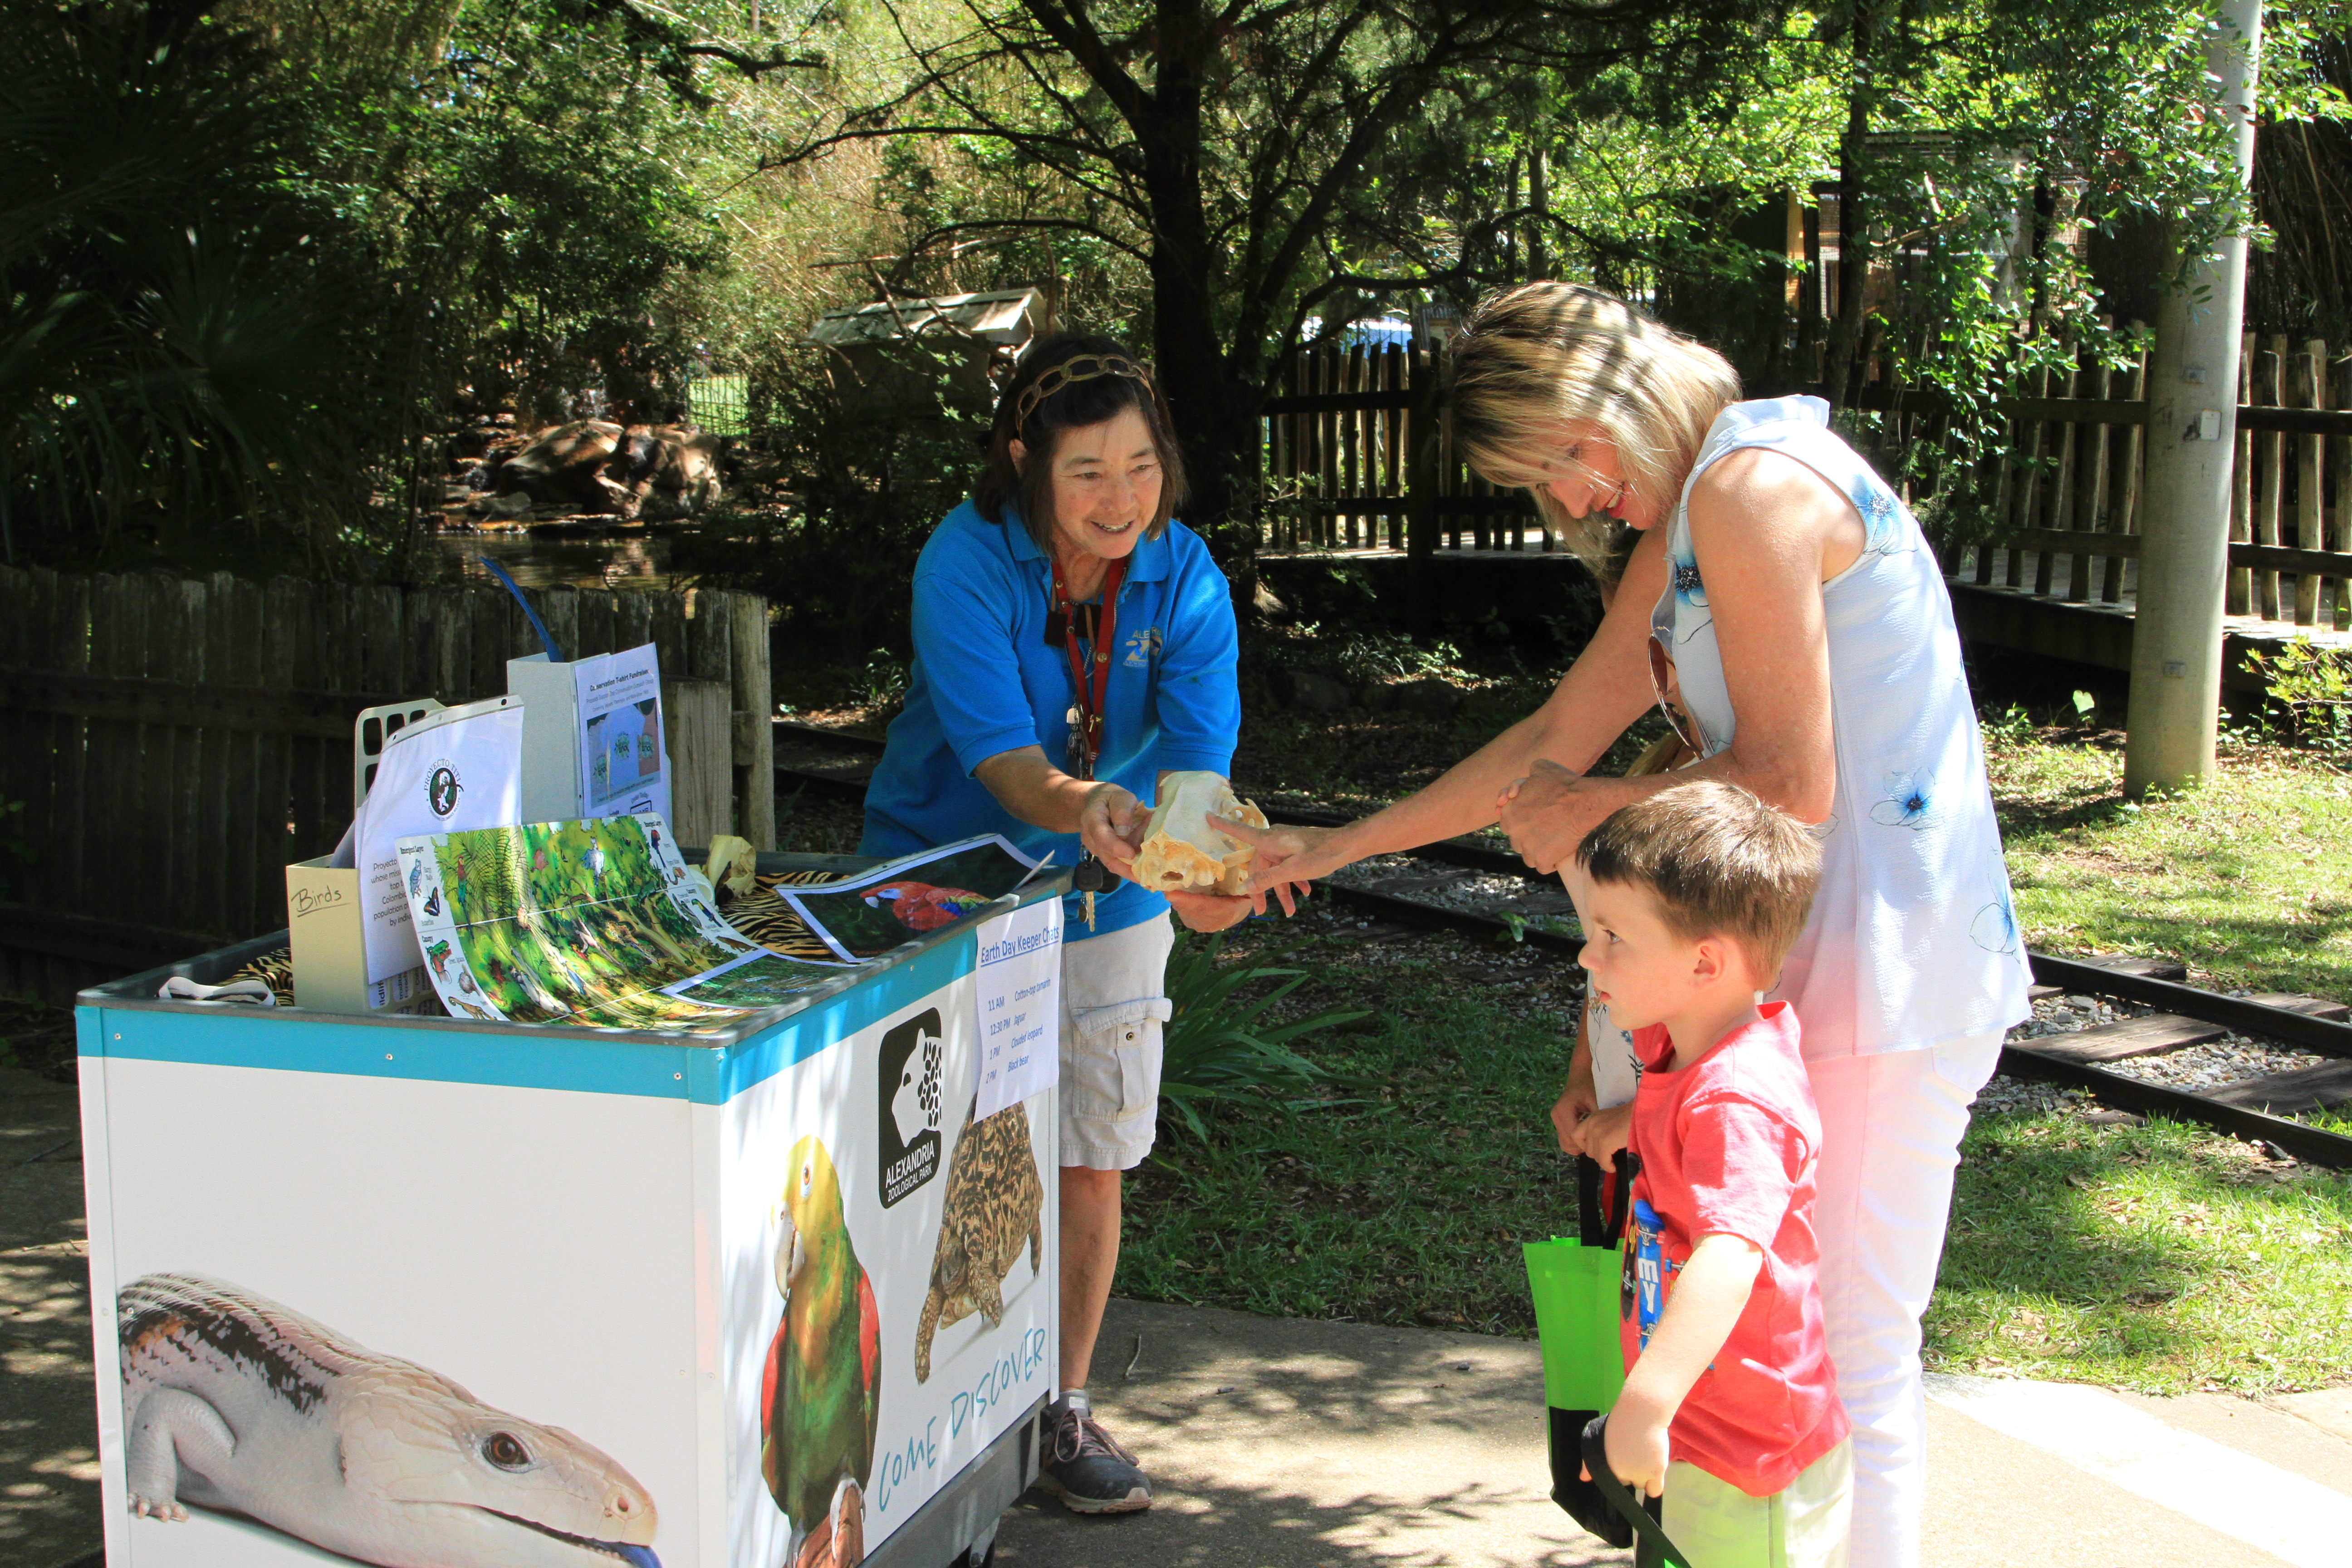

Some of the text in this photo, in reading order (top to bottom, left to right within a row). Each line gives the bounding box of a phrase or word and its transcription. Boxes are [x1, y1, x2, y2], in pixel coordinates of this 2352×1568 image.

[590, 679, 615, 691] Coservation
[424, 759, 450, 791] PROYECTO
[371, 868, 401, 884] whose missi
[373, 858, 397, 871] Proyecto
[291, 885, 342, 912] Birds
[390, 882, 400, 890] top
[374, 906, 402, 921] population
[389, 914, 412, 926] by indiv
[981, 925, 1059, 963] Earth Day Keeper Chats
[988, 977, 1051, 1011] 11 AM Cotton-top tamarin
[990, 1012, 1026, 1036] 12:30 PM Jaguar
[993, 1045, 1000, 1058] PM
[1011, 1032, 1027, 1049] Clouded
[1026, 1024, 1043, 1041] leopard
[989, 1068, 997, 1083] PM
[1008, 1058, 1018, 1072] Black
[1019, 1054, 1029, 1067] bear
[886, 1140, 935, 1189] ALEXANDRIA
[888, 1162, 932, 1202] ZOOLOGICAL PARK
[879, 1328, 1045, 1512] COME DISCOVER
